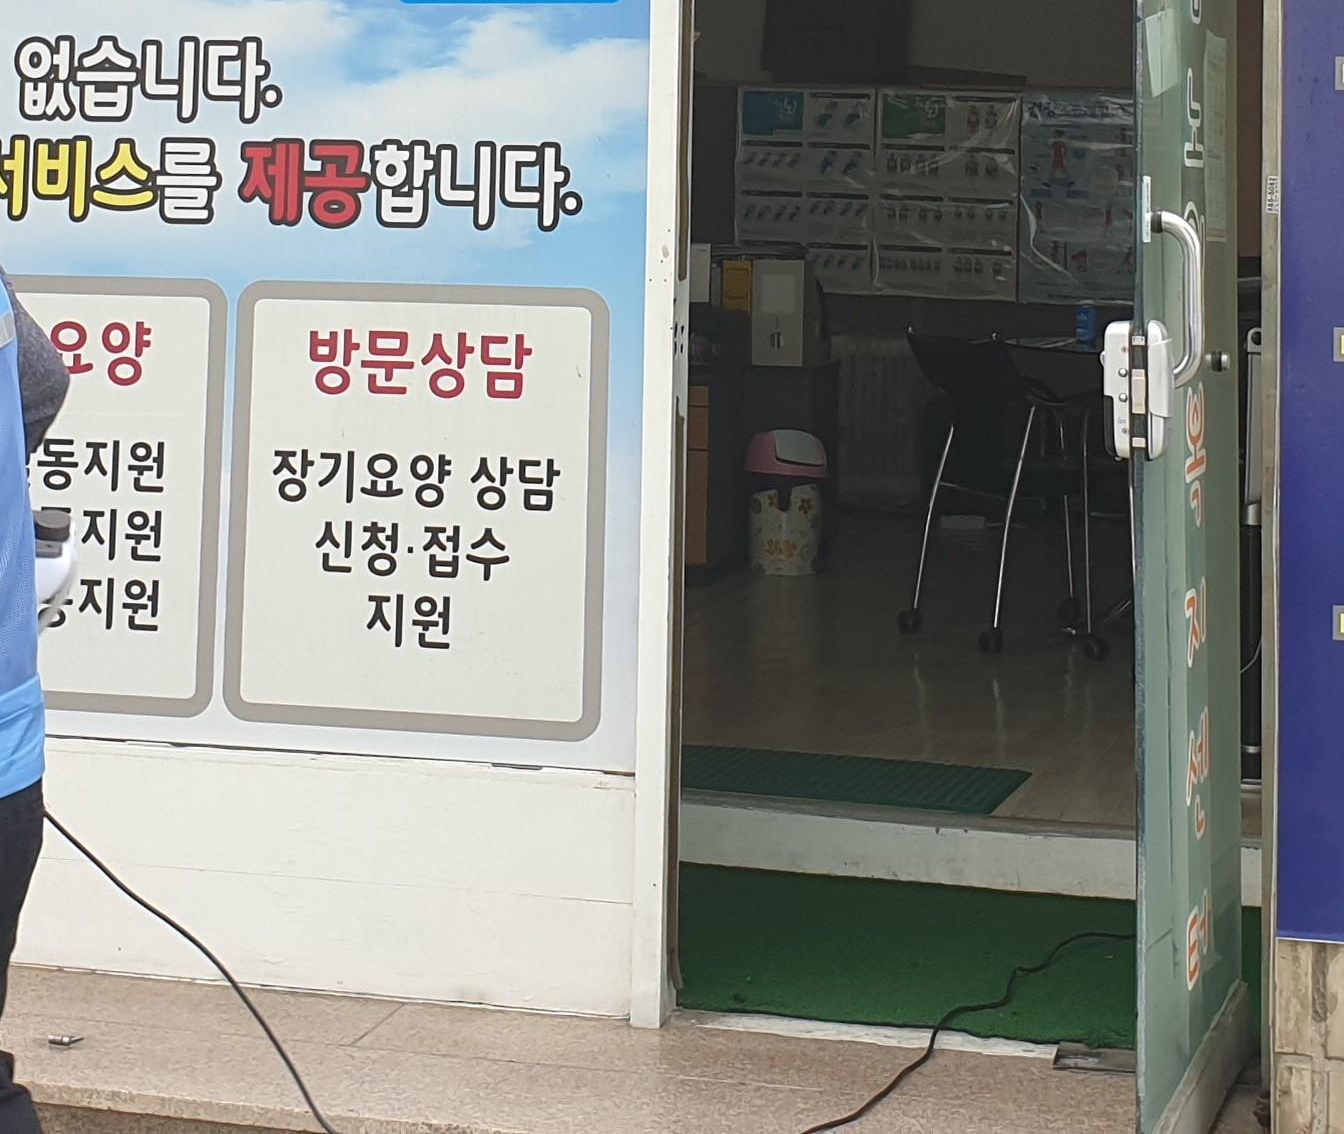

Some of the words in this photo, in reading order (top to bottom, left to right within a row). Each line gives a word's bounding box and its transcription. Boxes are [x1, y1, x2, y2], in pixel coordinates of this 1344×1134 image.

[14, 35, 283, 122] 없습니다.
[239, 137, 583, 232] 제공합니다.
[308, 327, 533, 400] 방문상담
[29, 438, 166, 494] 동지원
[272, 448, 454, 510] 장기요양
[469, 454, 562, 514] 상담
[41, 506, 163, 563] 지원
[365, 592, 454, 650] 지원
